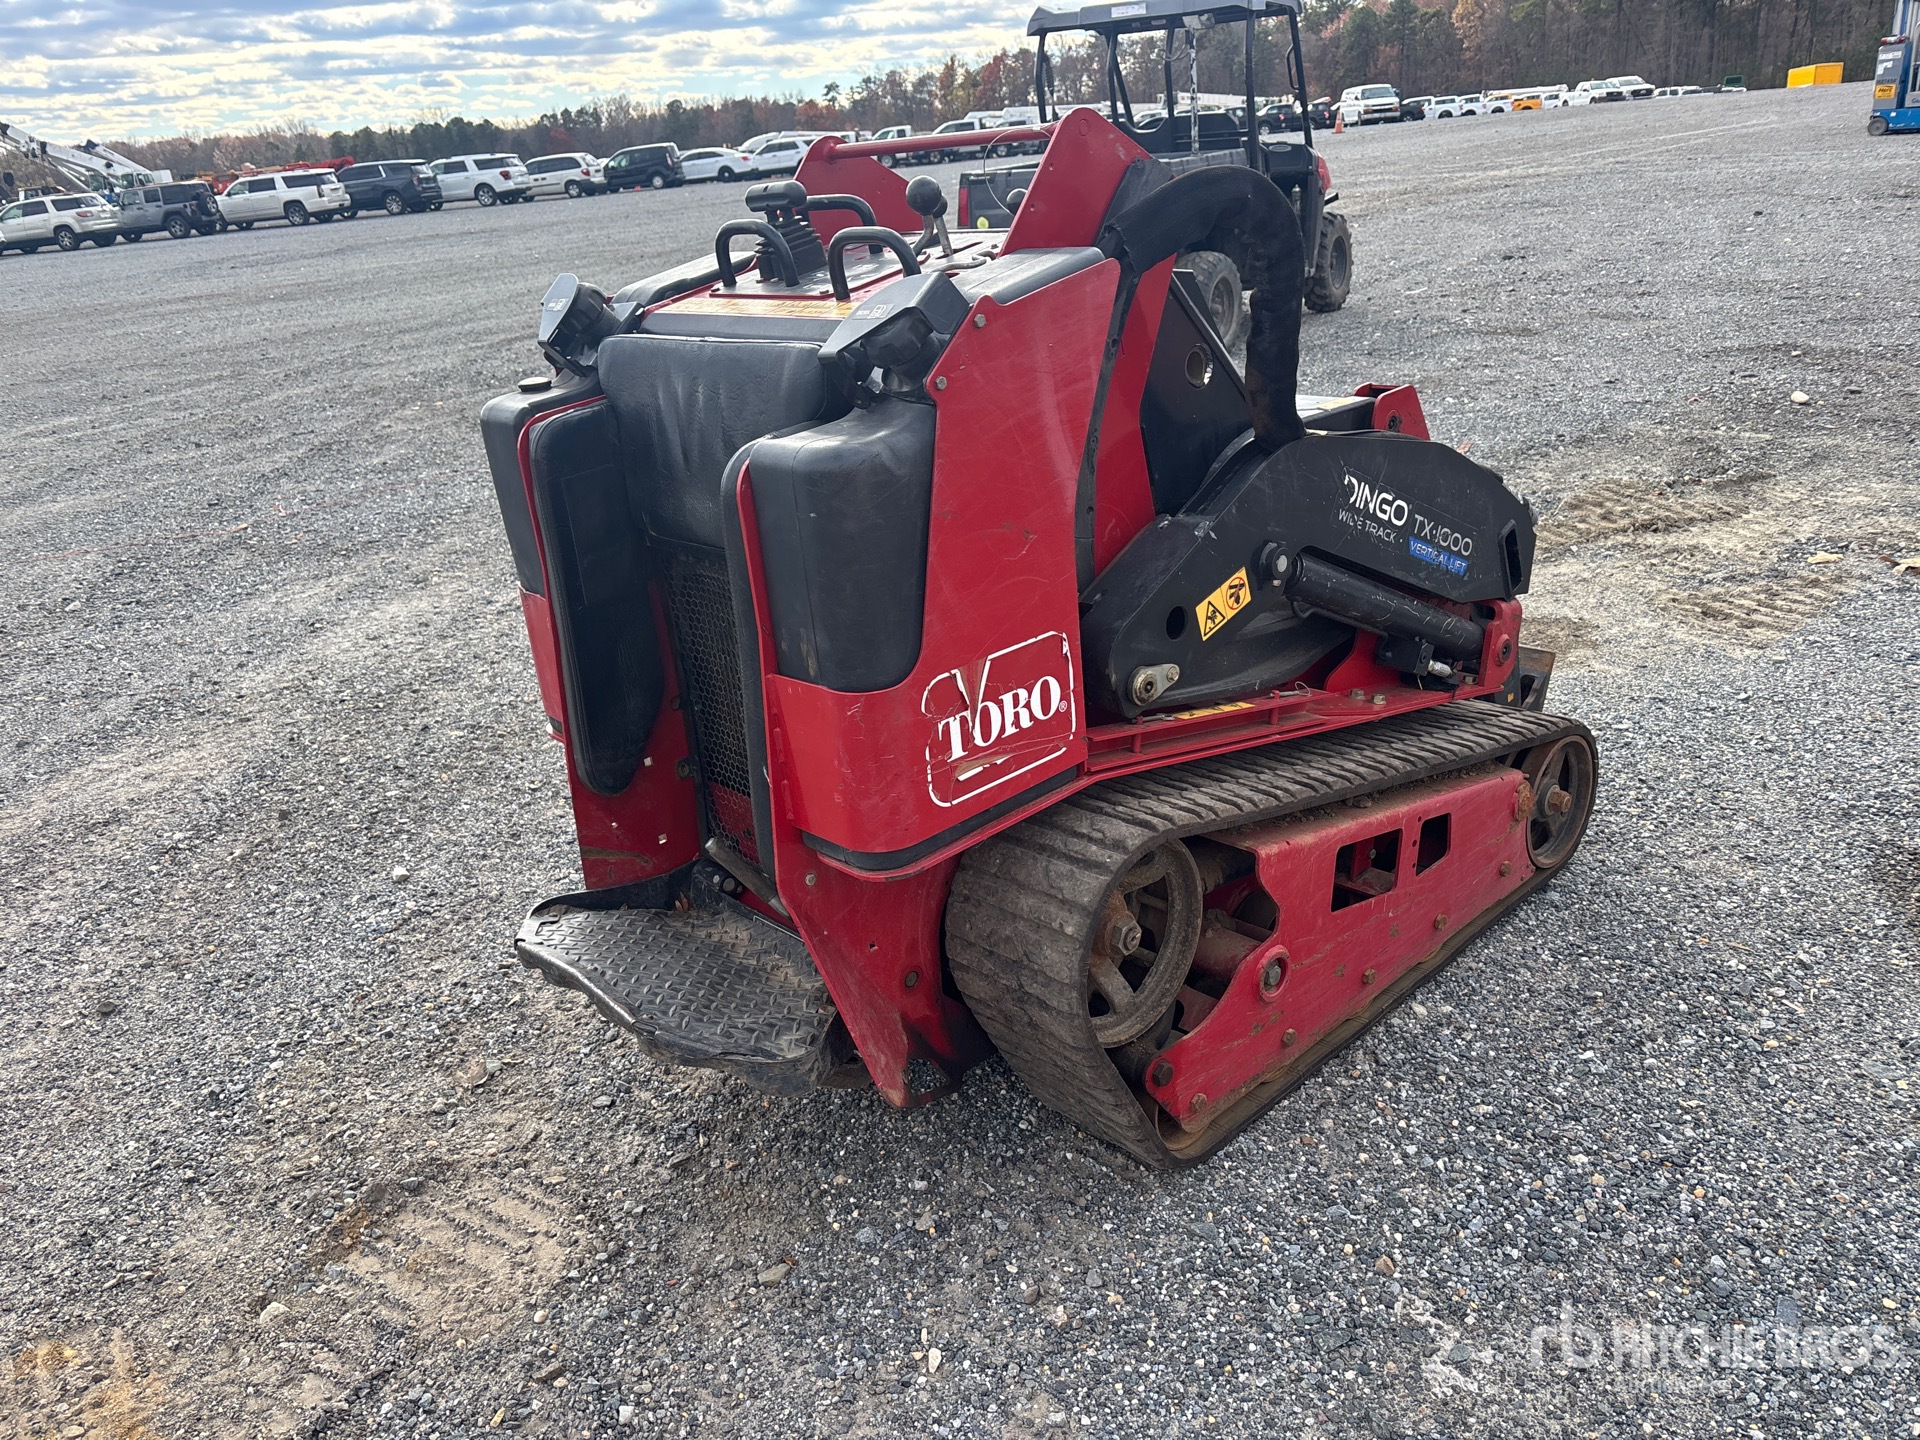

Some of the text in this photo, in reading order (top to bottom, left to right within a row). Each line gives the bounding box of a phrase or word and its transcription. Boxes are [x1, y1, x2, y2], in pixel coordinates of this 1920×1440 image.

[1344, 474, 1409, 527] DINGO
[1364, 519, 1398, 544] TRACK
[1410, 540, 1467, 573] VERTICAL LIFT
